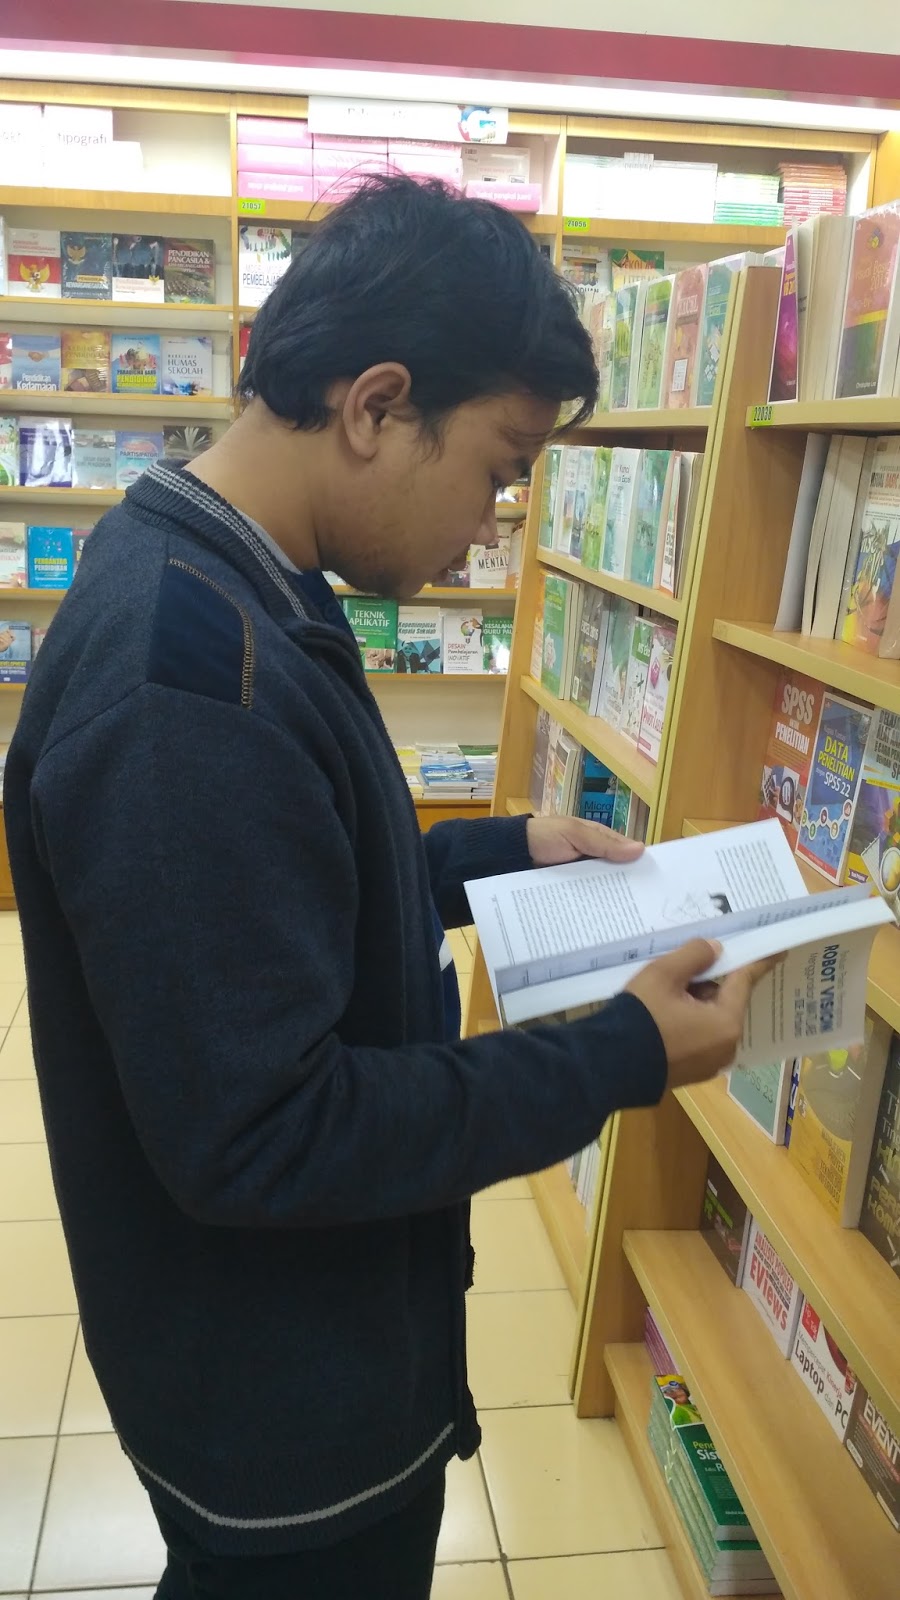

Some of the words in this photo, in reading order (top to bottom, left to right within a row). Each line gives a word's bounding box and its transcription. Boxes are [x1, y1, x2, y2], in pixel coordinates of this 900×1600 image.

[57, 132, 107, 147] tipografi
[242, 202, 261, 210] 21057
[167, 255, 203, 265] PANCASILA
[168, 249, 209, 260] PENDIDIKAN
[168, 358, 198, 368] HUMAS
[168, 366, 204, 376] SEKOLAH
[752, 406, 772, 422] 22038
[478, 556, 509, 571] MENTAL
[348, 618, 391, 628] APLIKATIF
[354, 610, 386, 620] TEKNIK
[398, 628, 416, 637] Kepala
[416, 628, 437, 637] Sekolah
[483, 628, 502, 637] GURU
[447, 643, 467, 651] DESAIN
[781, 683, 815, 725] SPSS
[775, 720, 810, 757] PENELITIAN
[824, 736, 849, 763] DATA
[817, 751, 856, 783] PENELITIAN
[824, 771, 842, 793] SPSS
[840, 781, 852, 799] 22
[820, 943, 841, 983] ROBOT
[820, 986, 836, 1034] VISION
[763, 1084, 774, 1104] 23
[749, 1251, 788, 1332] EViews
[794, 1339, 826, 1395] Laptop
[834, 1398, 849, 1431] PC
[826, 1371, 844, 1400] Kinerja
[863, 1398, 900, 1466] EVENT
